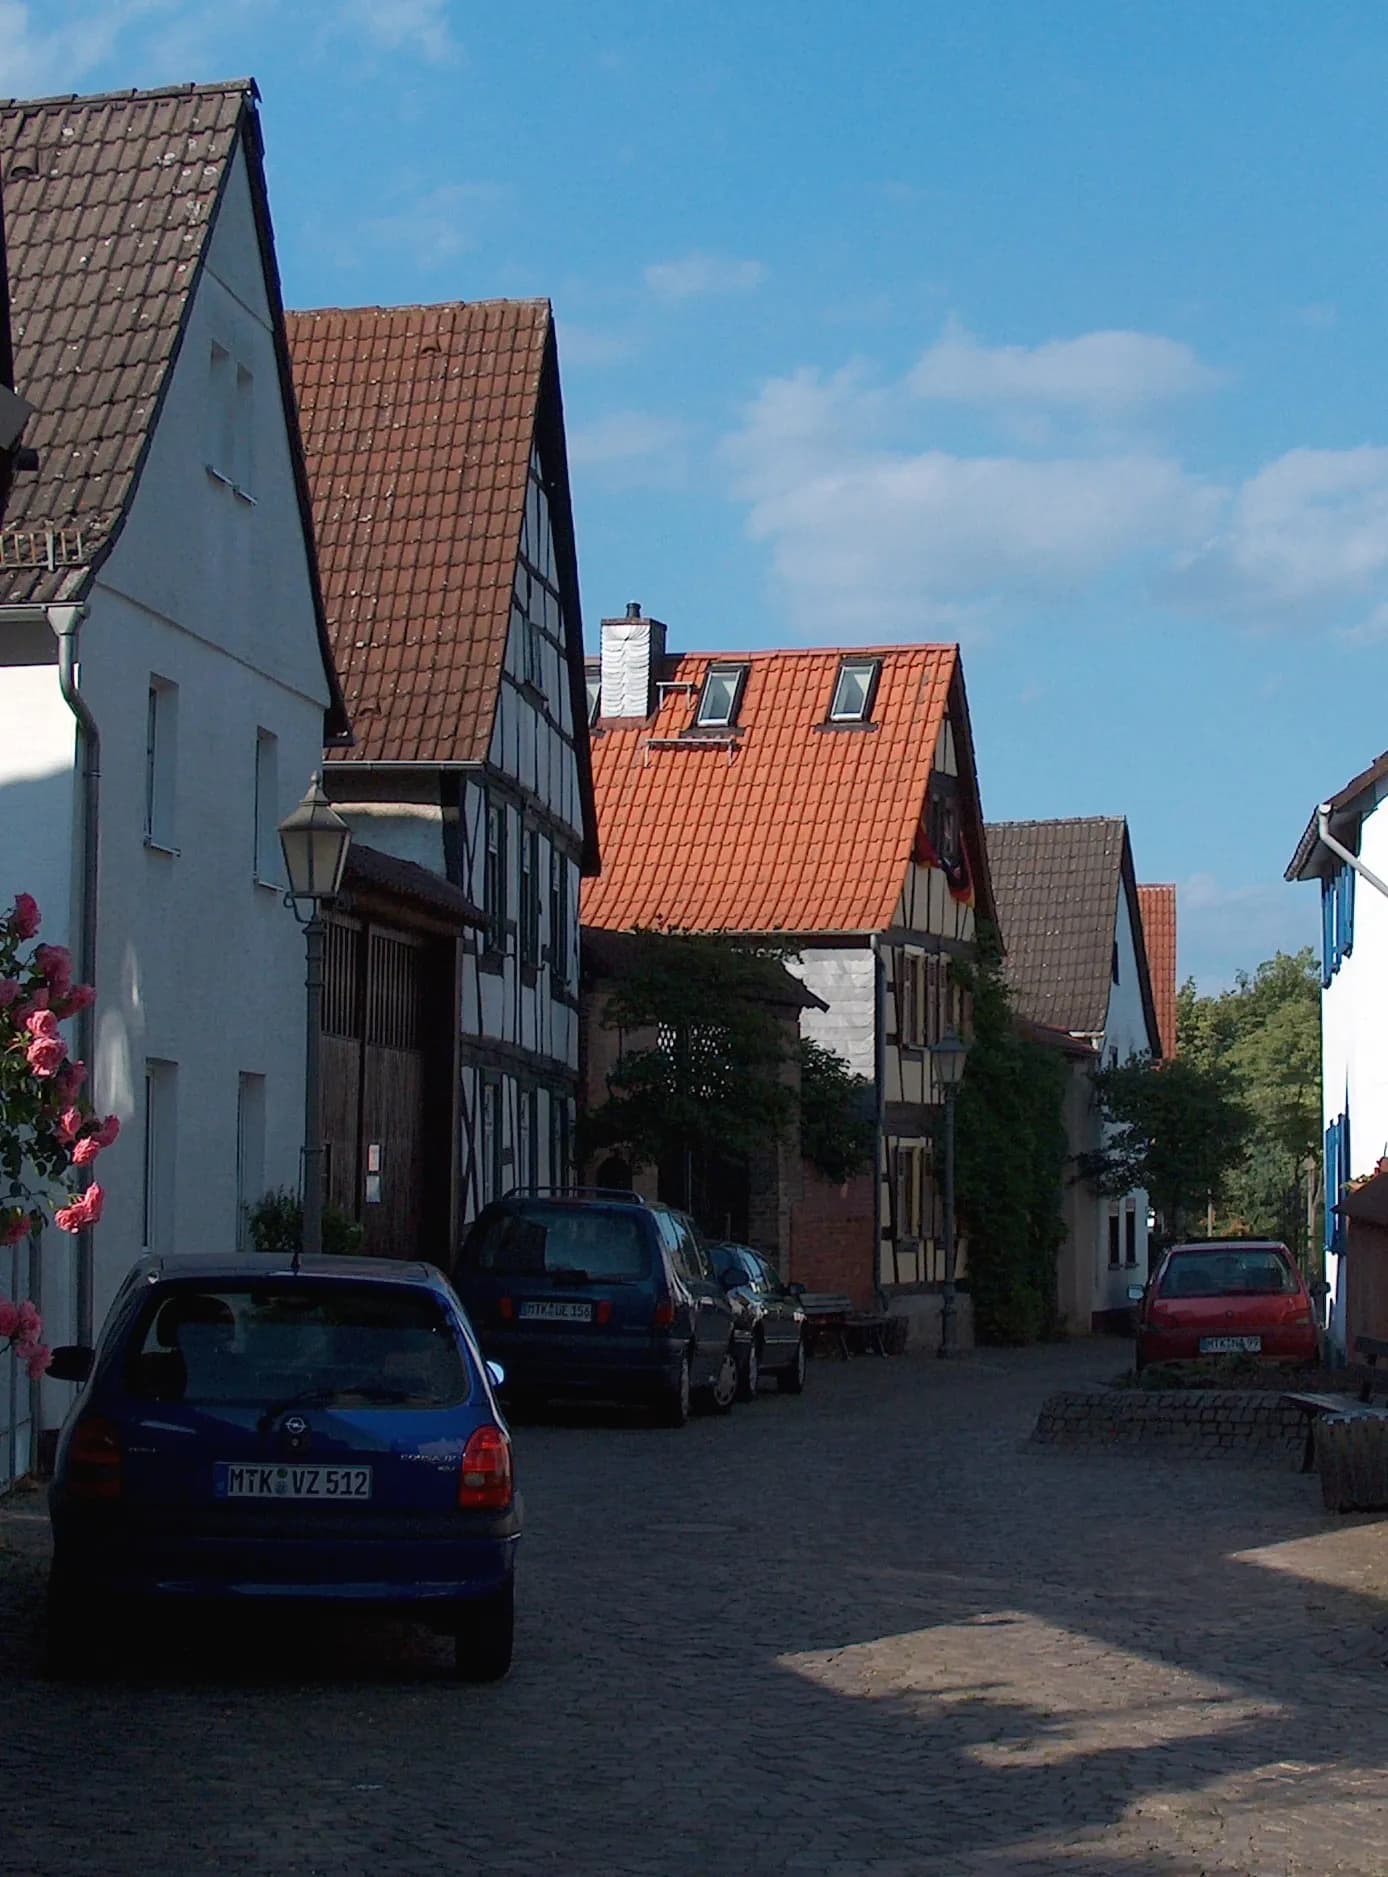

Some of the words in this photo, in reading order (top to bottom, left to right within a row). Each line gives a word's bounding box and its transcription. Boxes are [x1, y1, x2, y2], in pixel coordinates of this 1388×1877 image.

[229, 1468, 273, 1494] MTK
[292, 1470, 320, 1495] VZ
[326, 1470, 368, 1496] 512
